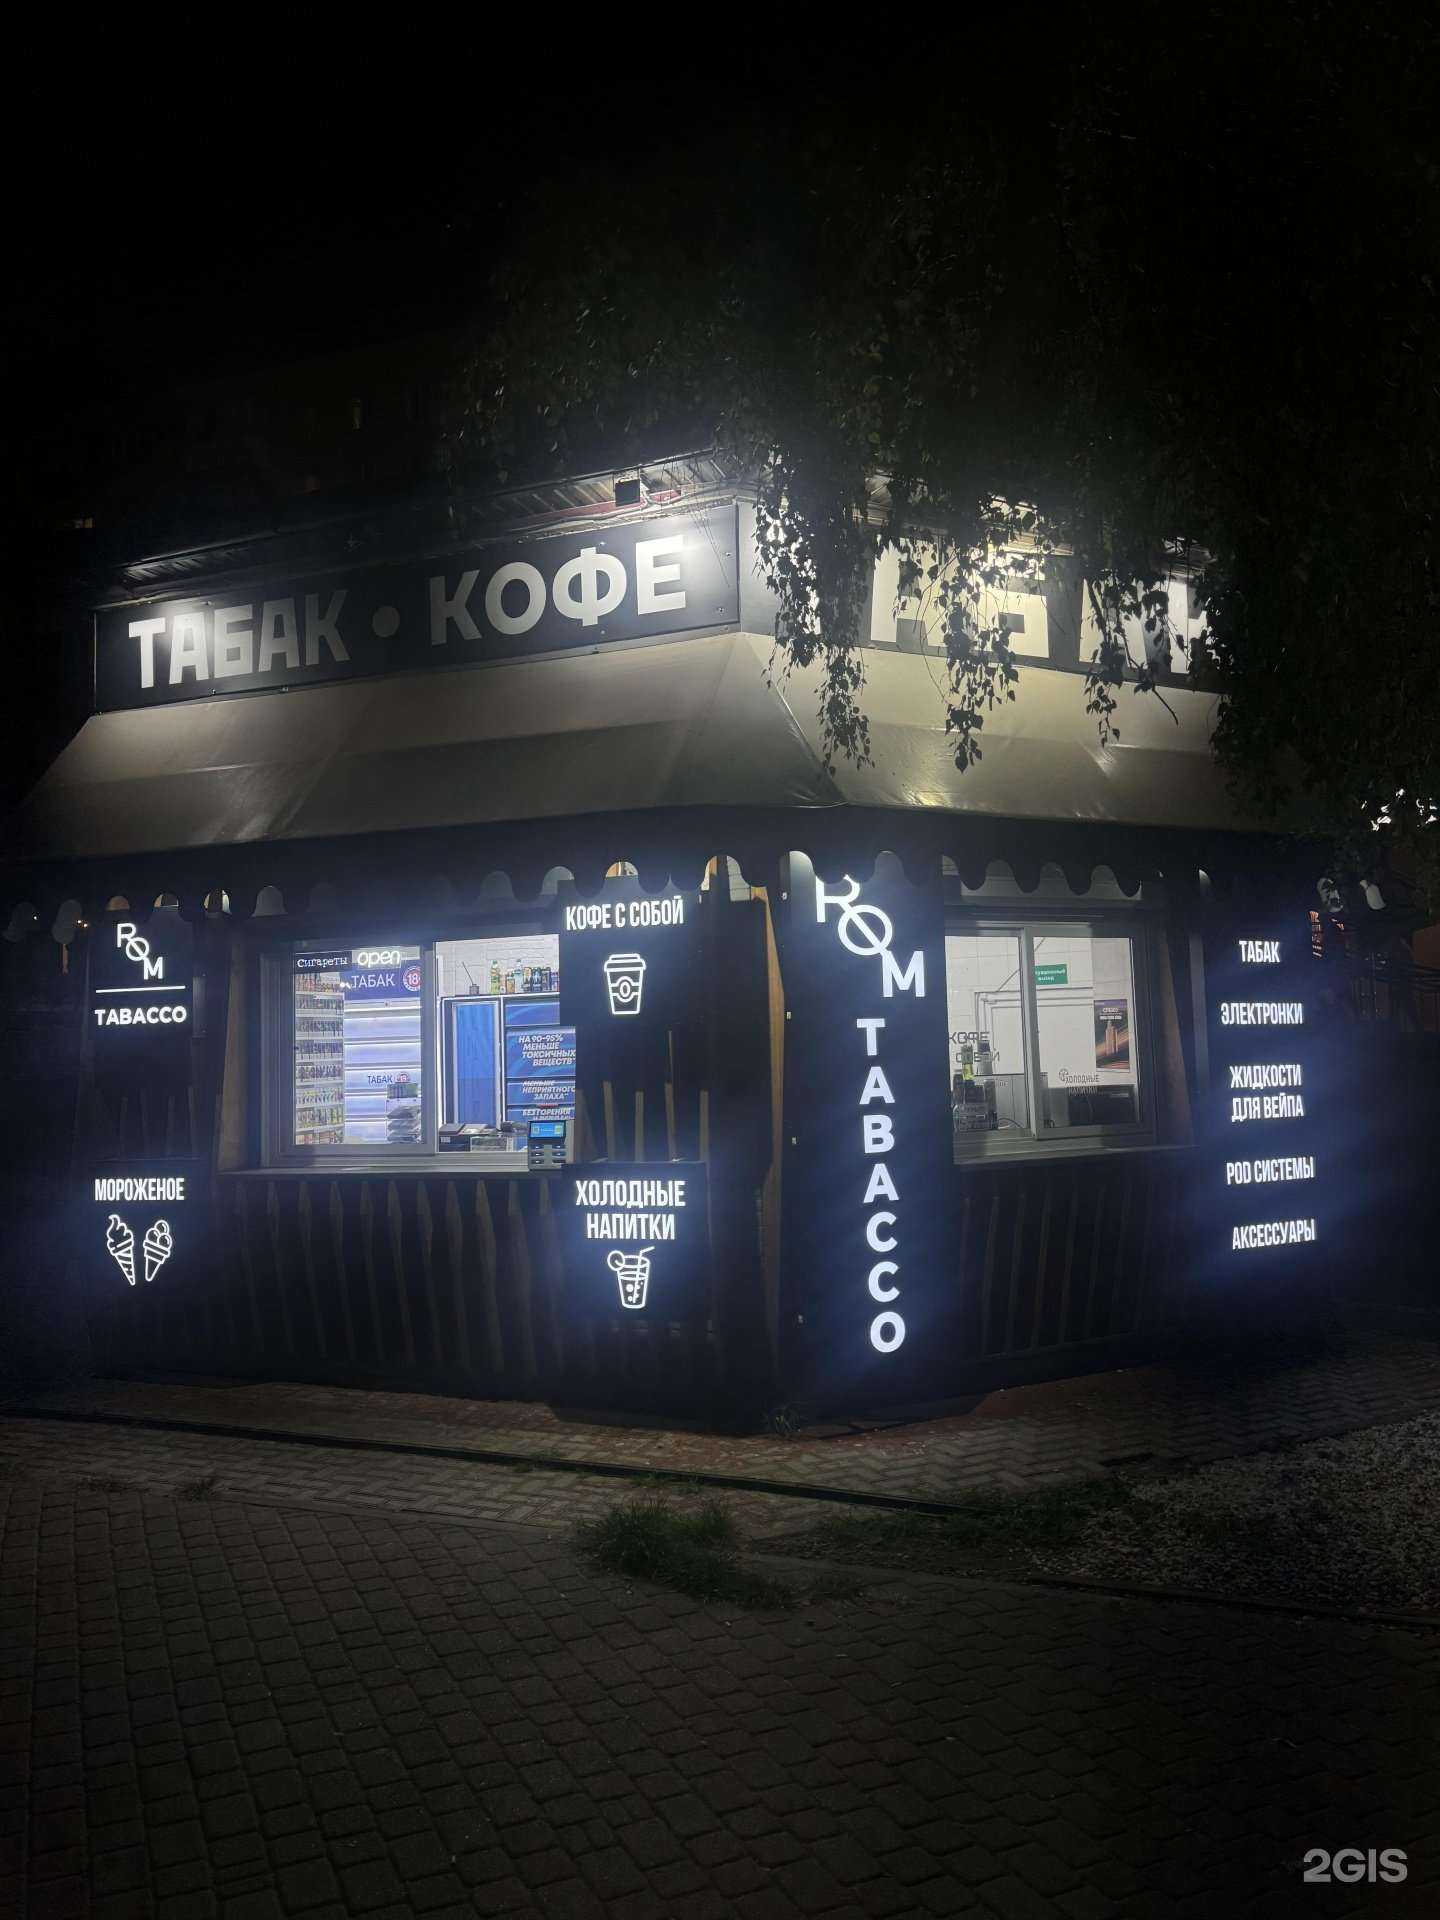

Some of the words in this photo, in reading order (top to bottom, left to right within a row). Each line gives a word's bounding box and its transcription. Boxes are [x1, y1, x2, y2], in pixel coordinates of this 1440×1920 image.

[128, 590, 350, 689] ТАБАК
[430, 534, 687, 646] КОФЕ
[566, 903, 611, 930] КОФЕ
[615, 902, 626, 928] С
[629, 895, 684, 927] СОБОЙ
[116, 923, 164, 980] ROM
[357, 950, 401, 968] open
[1239, 940, 1280, 963] ТАБАК
[351, 973, 396, 989] ТАБАК
[95, 1005, 187, 1026] TABACCO
[1220, 1002, 1304, 1026] ЭЛЕКТРОНКИ
[518, 1035, 531, 1043] НА
[523, 1042, 560, 1050] МЕНЬШЕ
[522, 1050, 576, 1059] ТОКСИЧНЫХ
[1229, 1064, 1301, 1090] ЖИДКОСТИ
[1231, 1097, 1261, 1123] ДЛЯ
[1263, 1093, 1304, 1119] ВЕЙПА
[1226, 1162, 1252, 1185] POD
[1254, 1156, 1315, 1183] СИСТЕМЫ
[95, 1178, 185, 1201] МОРОЖЕНОЕ
[575, 1180, 686, 1208] ХОЛОДНЫЕ
[856, 1018, 906, 1353] TABACCO
[586, 1213, 676, 1240] НАПИТКИ
[1232, 1218, 1316, 1250] АКСЕССУАРЫ
